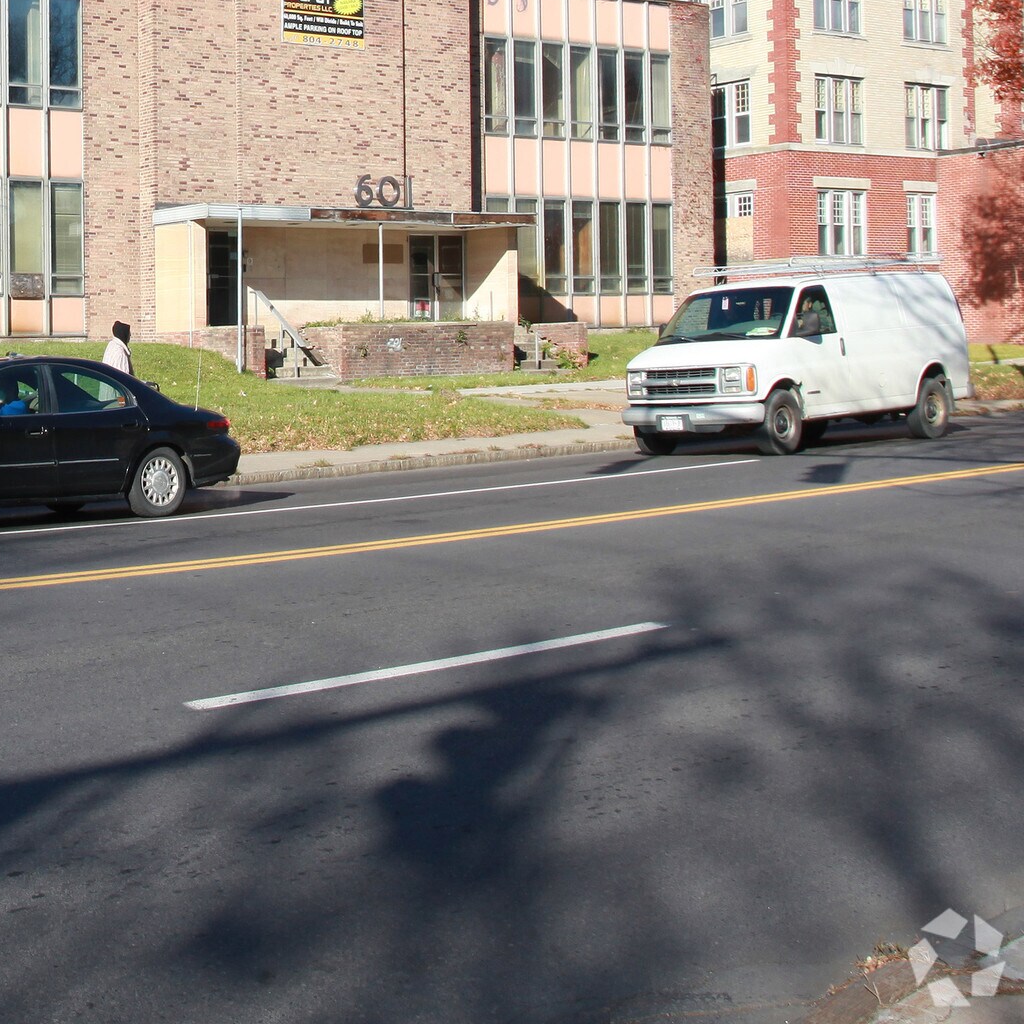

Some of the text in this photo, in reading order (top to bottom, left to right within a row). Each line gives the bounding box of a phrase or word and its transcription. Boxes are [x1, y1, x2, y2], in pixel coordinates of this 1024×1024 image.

[284, 2, 321, 12] PROPERTIES
[284, 22, 302, 30] AMPLE
[304, 24, 327, 33] PARKING
[353, 174, 412, 208] 601
